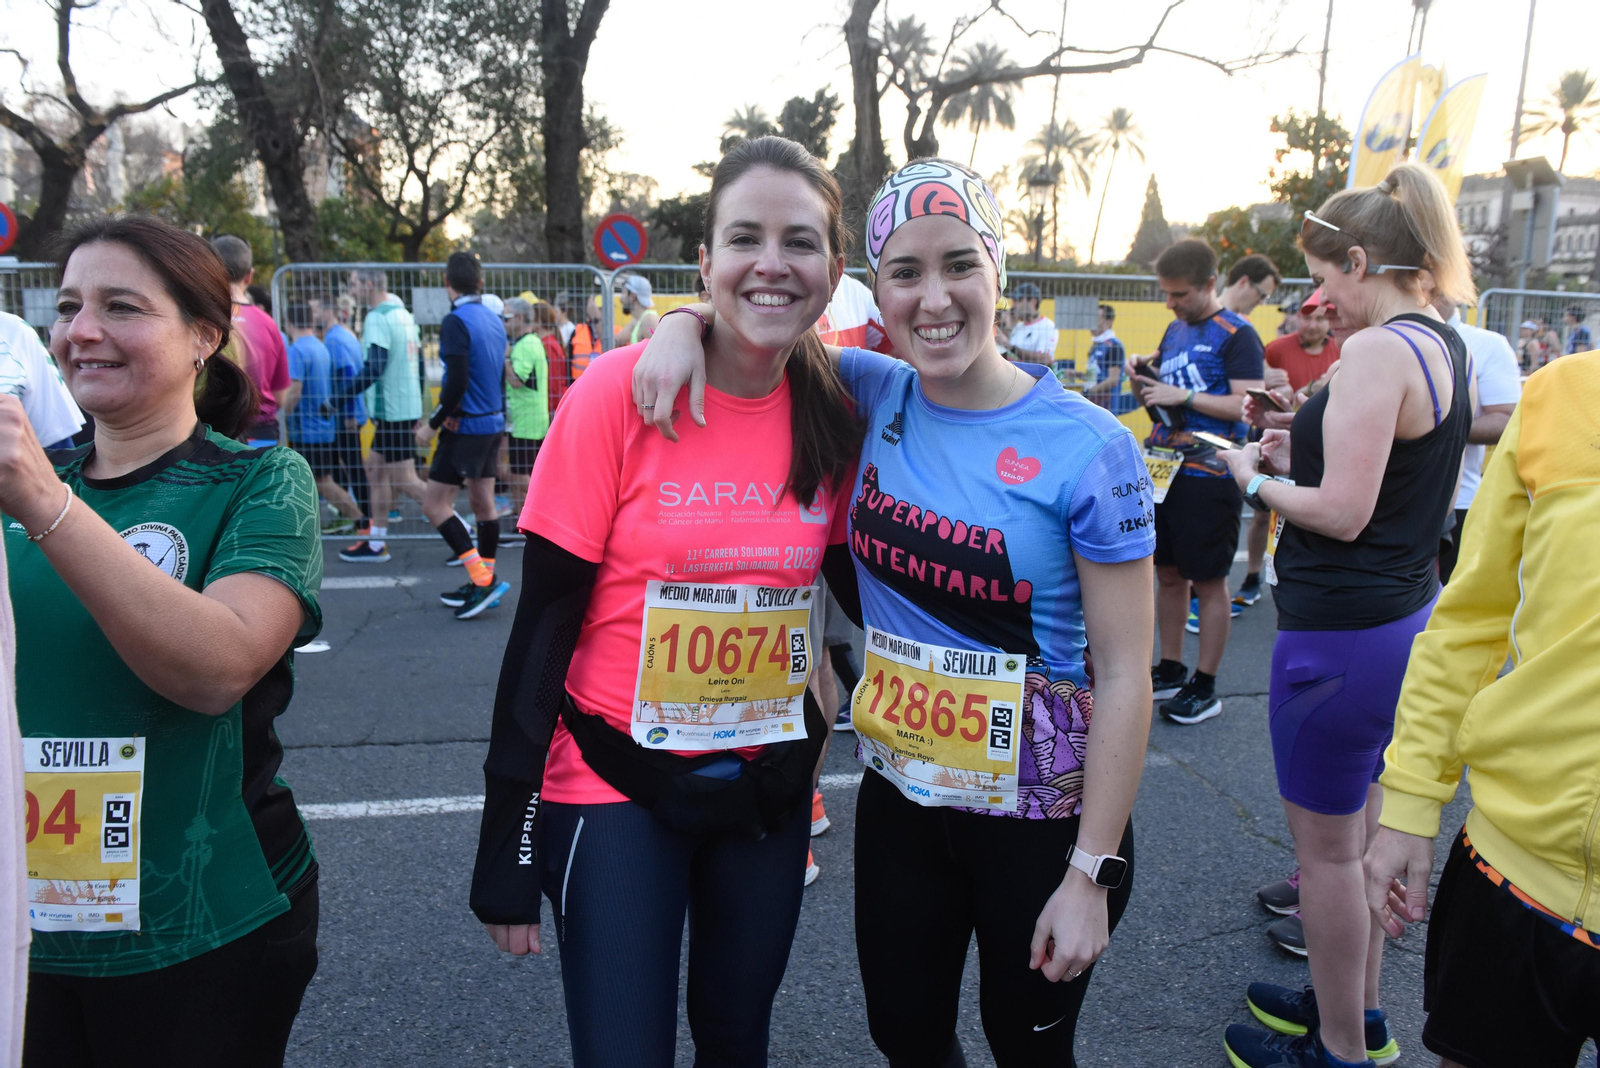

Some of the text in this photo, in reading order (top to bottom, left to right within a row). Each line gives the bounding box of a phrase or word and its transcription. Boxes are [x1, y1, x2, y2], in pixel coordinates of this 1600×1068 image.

[863, 463, 877, 481] EL
[657, 481, 784, 507] SARAY
[1111, 476, 1149, 499] RUNEA
[658, 510, 695, 518] Asociación
[669, 518, 693, 526] Cáncer
[857, 483, 1005, 555] SUPERPODER
[140, 524, 168, 533] DIVINA
[168, 529, 186, 556] PASORA
[174, 556, 187, 581] CÁDIZ
[783, 546, 819, 569] 2022
[659, 585, 798, 607] MEDIO MARATÓN SEVILLA
[646, 643, 656, 669] CAJÓN
[660, 623, 790, 675] 10674
[871, 631, 997, 676] MEDIO MARATÓN SEVILLA
[708, 677, 745, 685] Leire Oni
[699, 695, 747, 703] Onieva Iturgaiz
[868, 669, 988, 743] 12865
[712, 729, 736, 739] HOKA
[896, 729, 925, 744] MARTA
[40, 740, 109, 767] SEVILLA
[894, 746, 935, 763] Santos Royo
[907, 783, 931, 798] HOKA
[518, 792, 540, 865] KIPRUN
